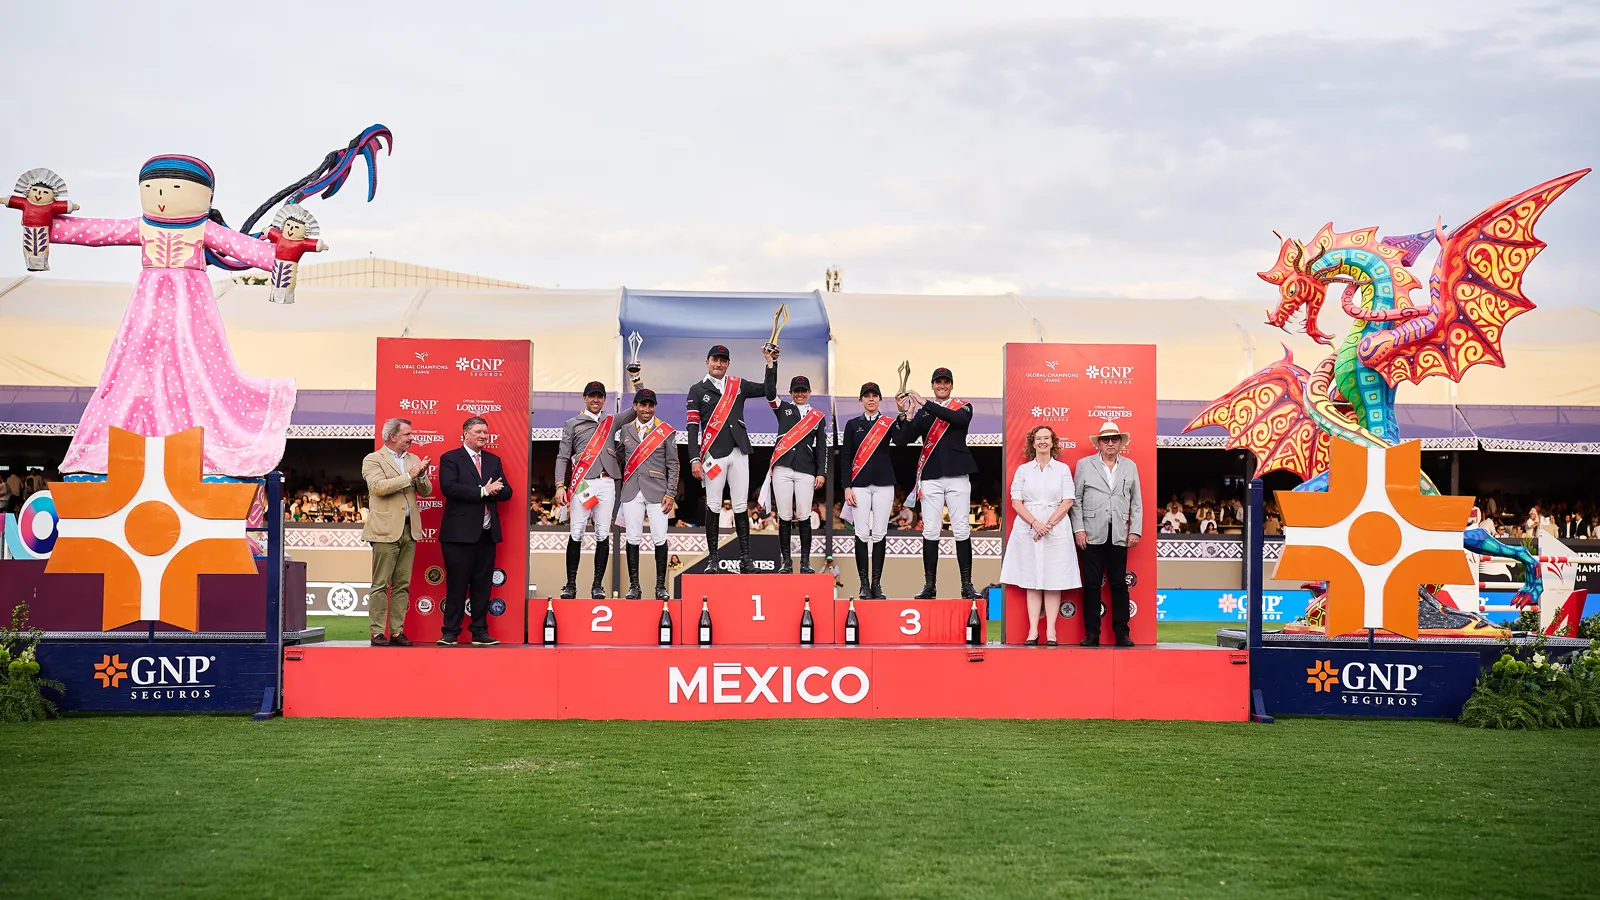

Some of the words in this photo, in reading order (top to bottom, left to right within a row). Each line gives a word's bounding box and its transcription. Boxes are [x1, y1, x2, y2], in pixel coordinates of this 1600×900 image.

[456, 404, 501, 412] LONGINES
[752, 594, 765, 621] 1
[591, 605, 613, 632] 2
[900, 608, 922, 635] 3
[131, 689, 211, 700] SEGUROS
[1341, 695, 1417, 706] SEGUROS
